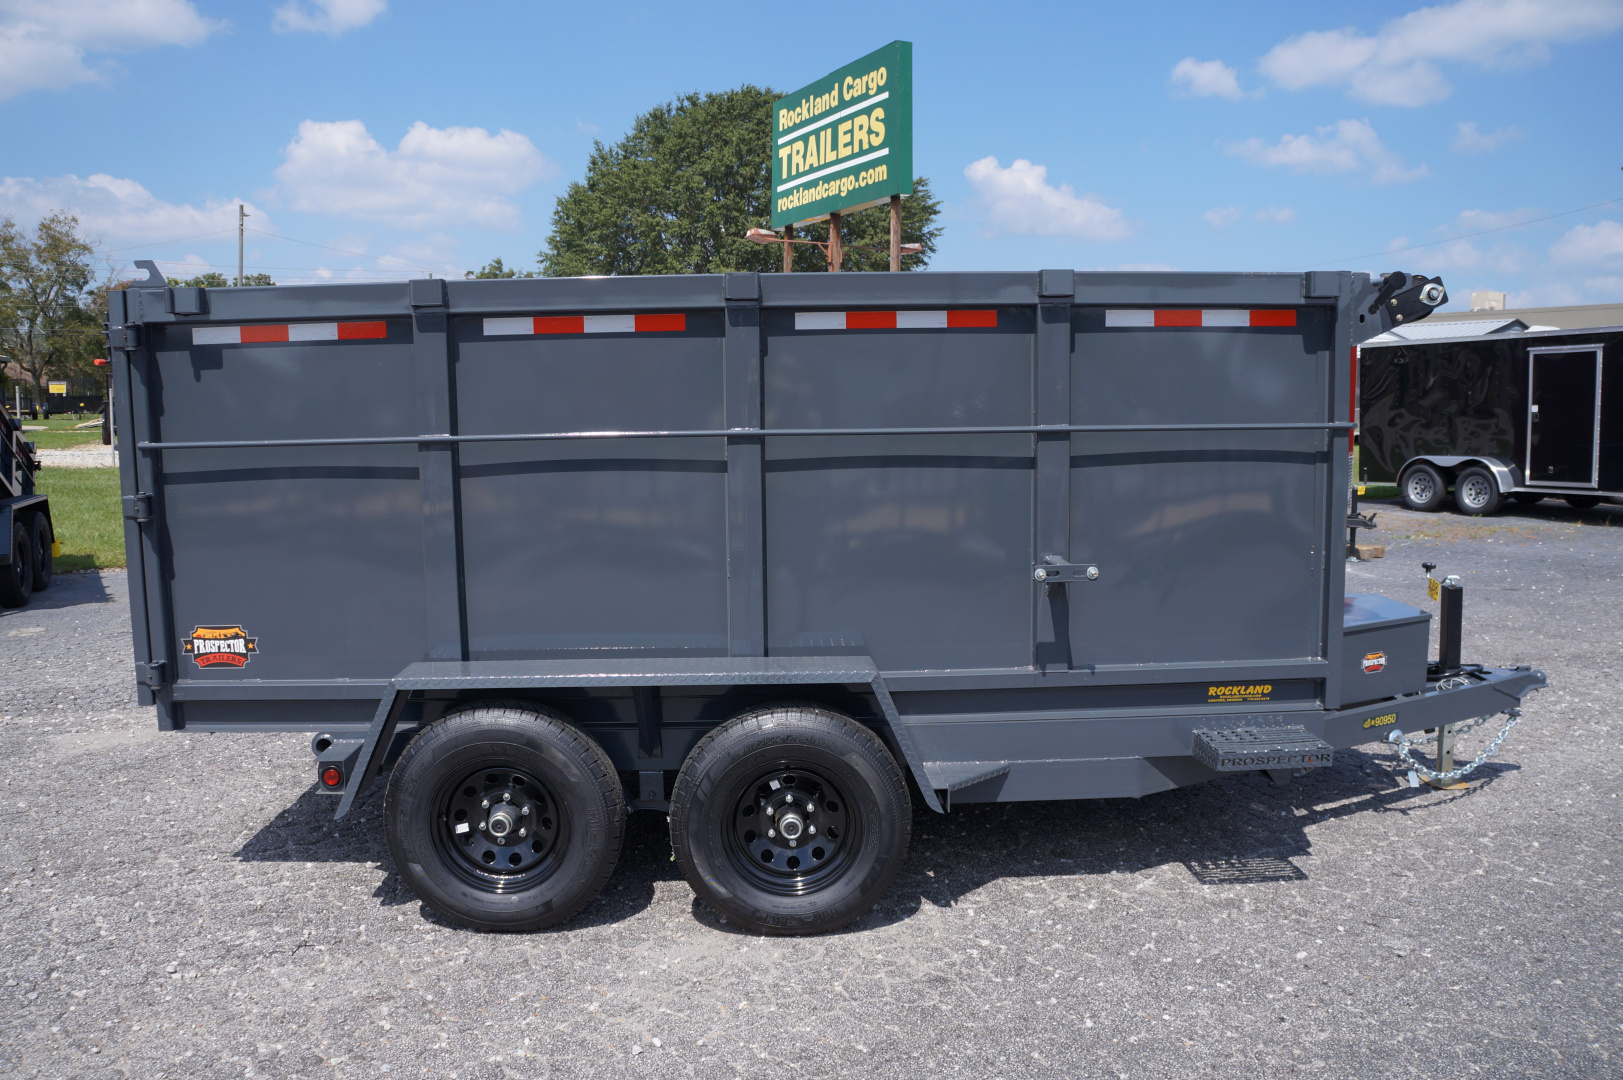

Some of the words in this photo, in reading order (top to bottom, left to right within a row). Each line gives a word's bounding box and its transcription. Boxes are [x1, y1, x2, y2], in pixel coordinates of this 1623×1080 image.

[779, 82, 839, 132] Rockland
[842, 66, 887, 101] Cargo
[778, 107, 886, 180] TRAILERS
[777, 164, 888, 213] rocklandcargo.com
[193, 638, 247, 654] PROSPECTOR
[200, 654, 243, 665] TRAILERS
[1208, 684, 1272, 696] ROCKLAND
[1374, 713, 1396, 727] 90950
[1221, 753, 1331, 767] PROSPECTOR
